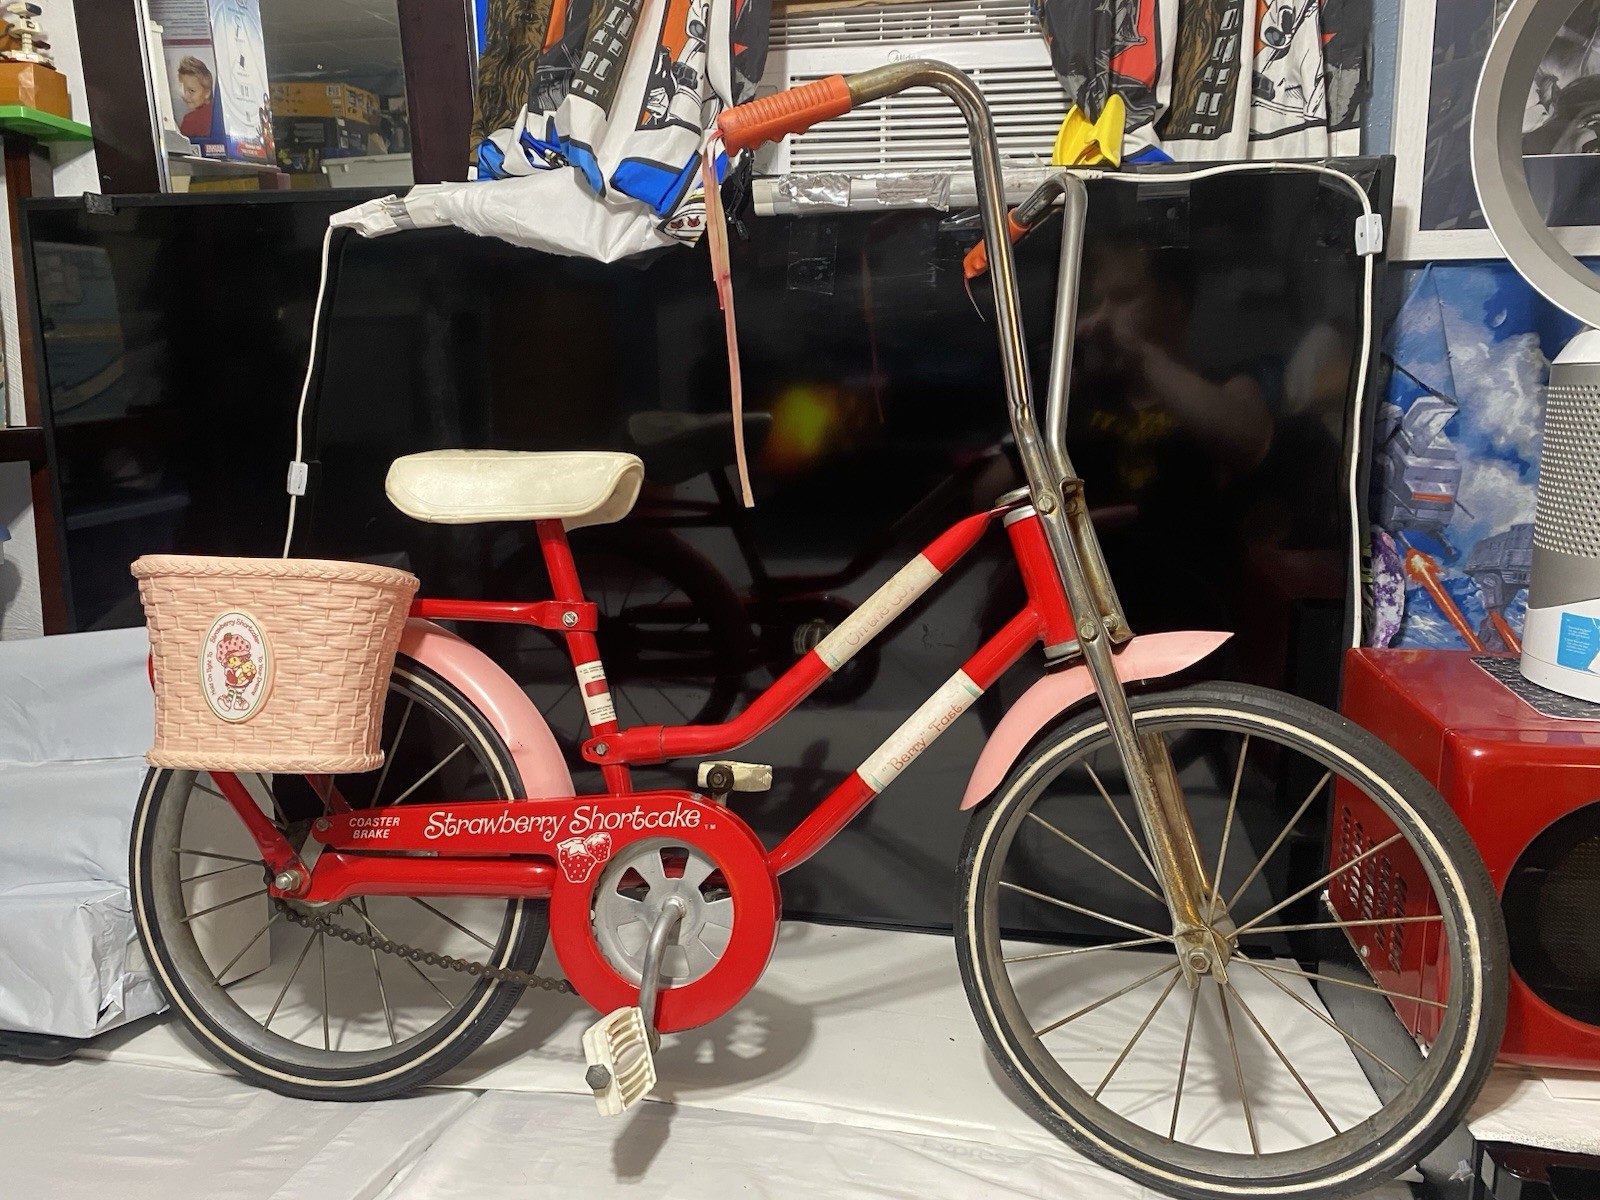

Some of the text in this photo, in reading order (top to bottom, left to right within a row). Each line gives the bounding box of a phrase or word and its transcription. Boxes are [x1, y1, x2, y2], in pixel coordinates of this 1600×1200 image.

[928, 704, 964, 733] Fast
[348, 816, 400, 828] COASTER
[424, 809, 566, 842] Strawberry
[568, 801, 701, 834] Shortcake
[352, 828, 390, 839] BRAKE
